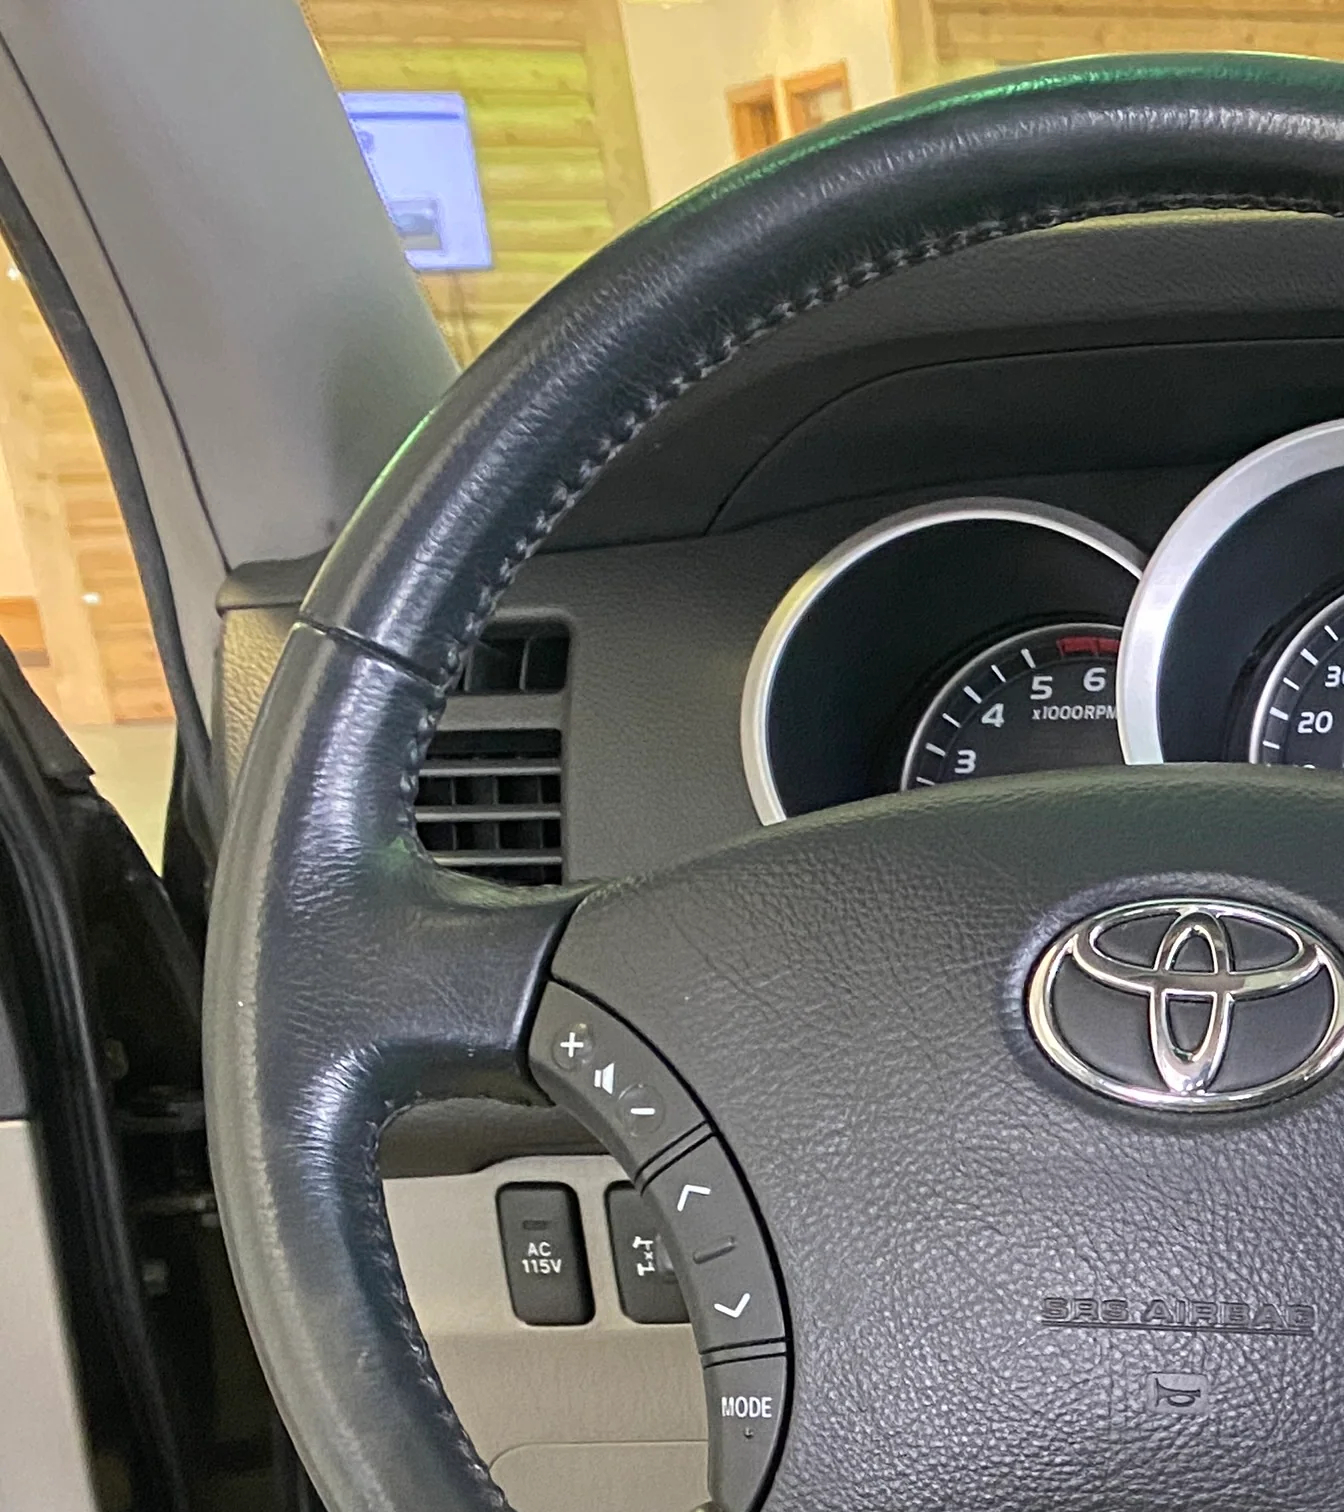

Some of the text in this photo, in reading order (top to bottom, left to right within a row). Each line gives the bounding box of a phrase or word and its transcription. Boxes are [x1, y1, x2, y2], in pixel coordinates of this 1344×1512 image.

[1030, 676, 1053, 700] 5
[1083, 667, 1107, 692] 6
[981, 704, 1005, 728] 4
[1297, 711, 1333, 733] 20
[954, 750, 977, 774] 3
[527, 1242, 551, 1258] AC
[521, 1258, 562, 1275] 115V
[1042, 1297, 1316, 1328] SRS AIRBAG
[721, 1396, 772, 1418] MODE
